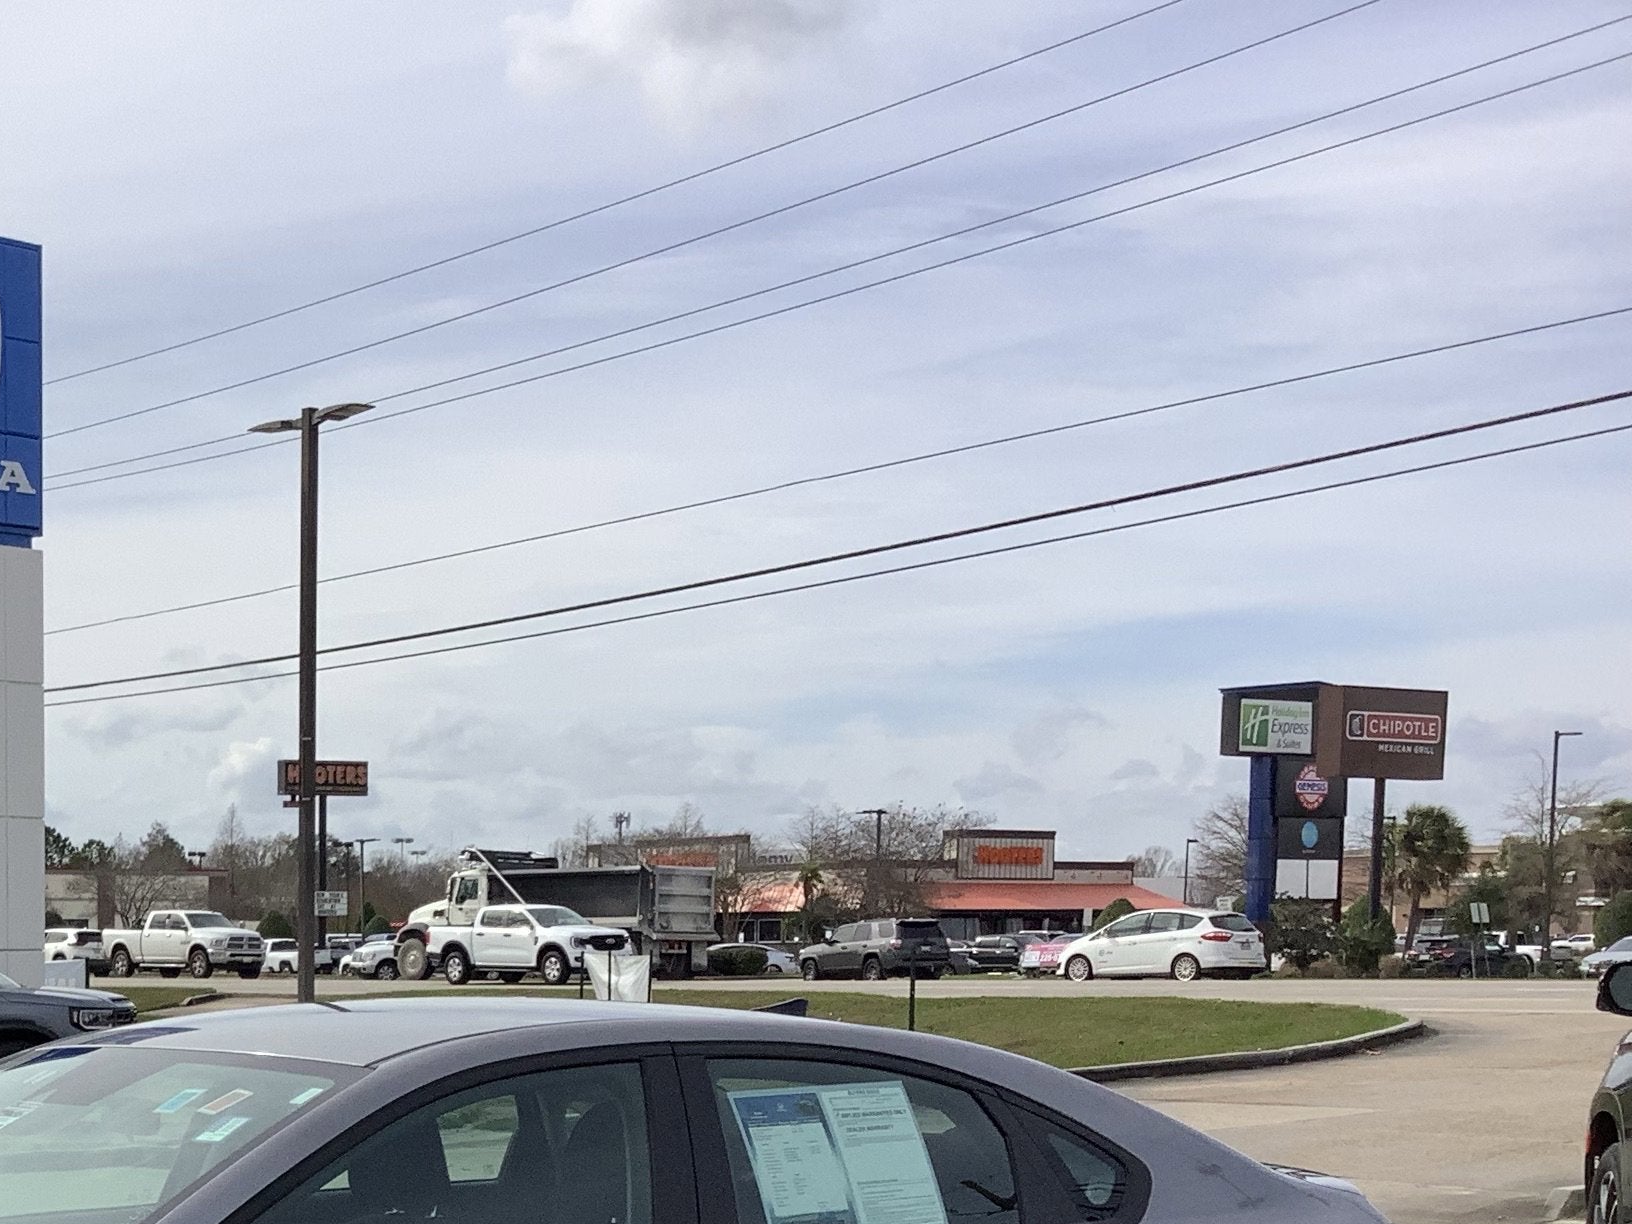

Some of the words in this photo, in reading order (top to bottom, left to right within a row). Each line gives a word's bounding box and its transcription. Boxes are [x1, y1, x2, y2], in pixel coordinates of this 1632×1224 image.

[1271, 718, 1310, 737] Express
[1369, 718, 1437, 737] CHIPOTLE
[1378, 743, 1412, 753] MEXICAN
[1413, 745, 1435, 755] GRILL
[287, 763, 367, 786] HOTERS
